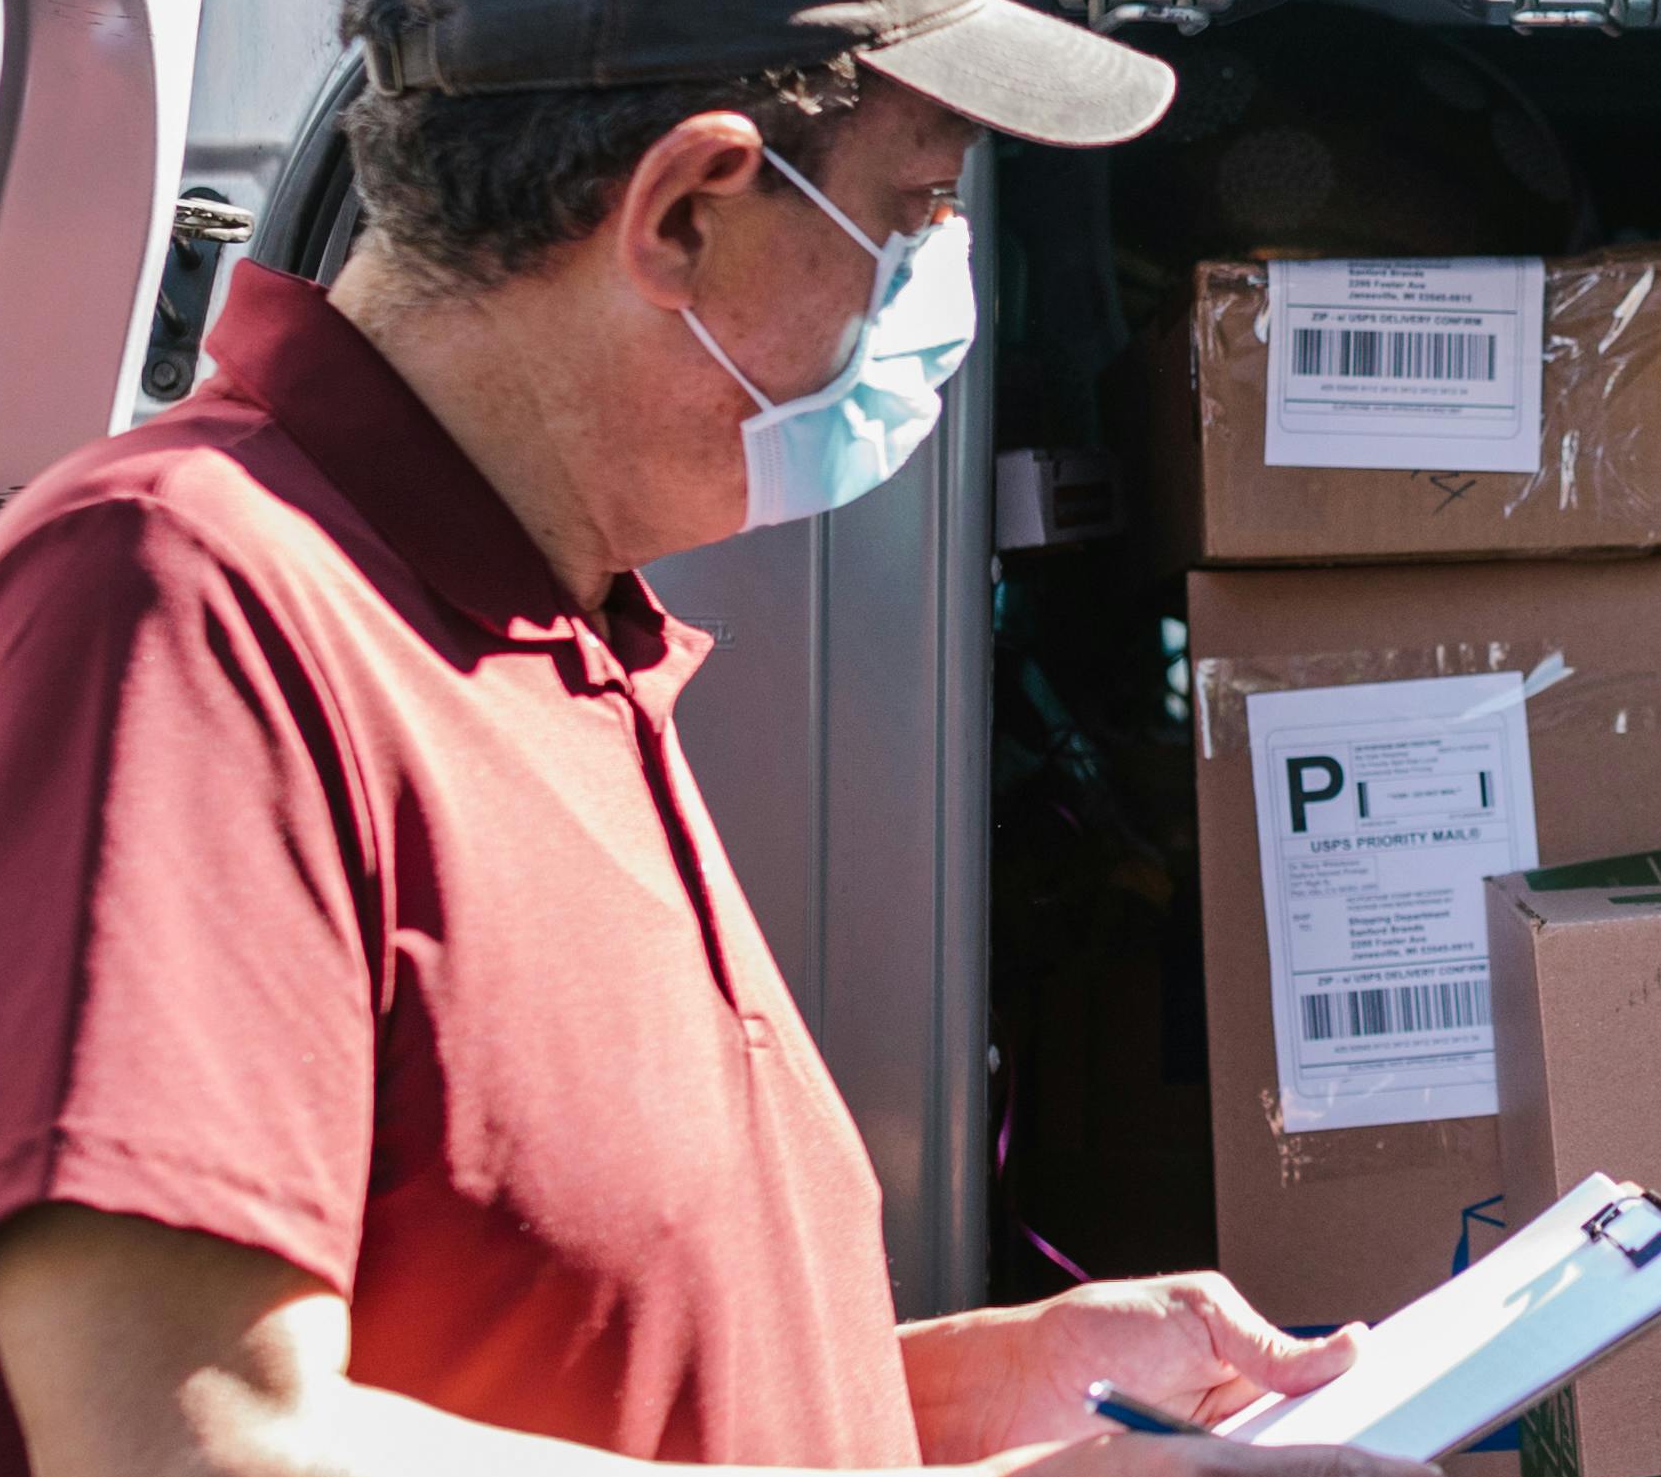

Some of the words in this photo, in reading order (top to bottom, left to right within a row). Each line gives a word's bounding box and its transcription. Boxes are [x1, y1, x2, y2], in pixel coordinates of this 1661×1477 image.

[1348, 314, 1376, 323] USPS
[1379, 315, 1430, 324] DELIVERY
[1434, 316, 1481, 325] CONFIRM
[1285, 753, 1348, 832] P
[1310, 838, 1351, 853] USPS
[1357, 832, 1426, 849] PRIORITY
[1354, 972, 1381, 984] USPS
[1385, 968, 1435, 980] DELIVERY
